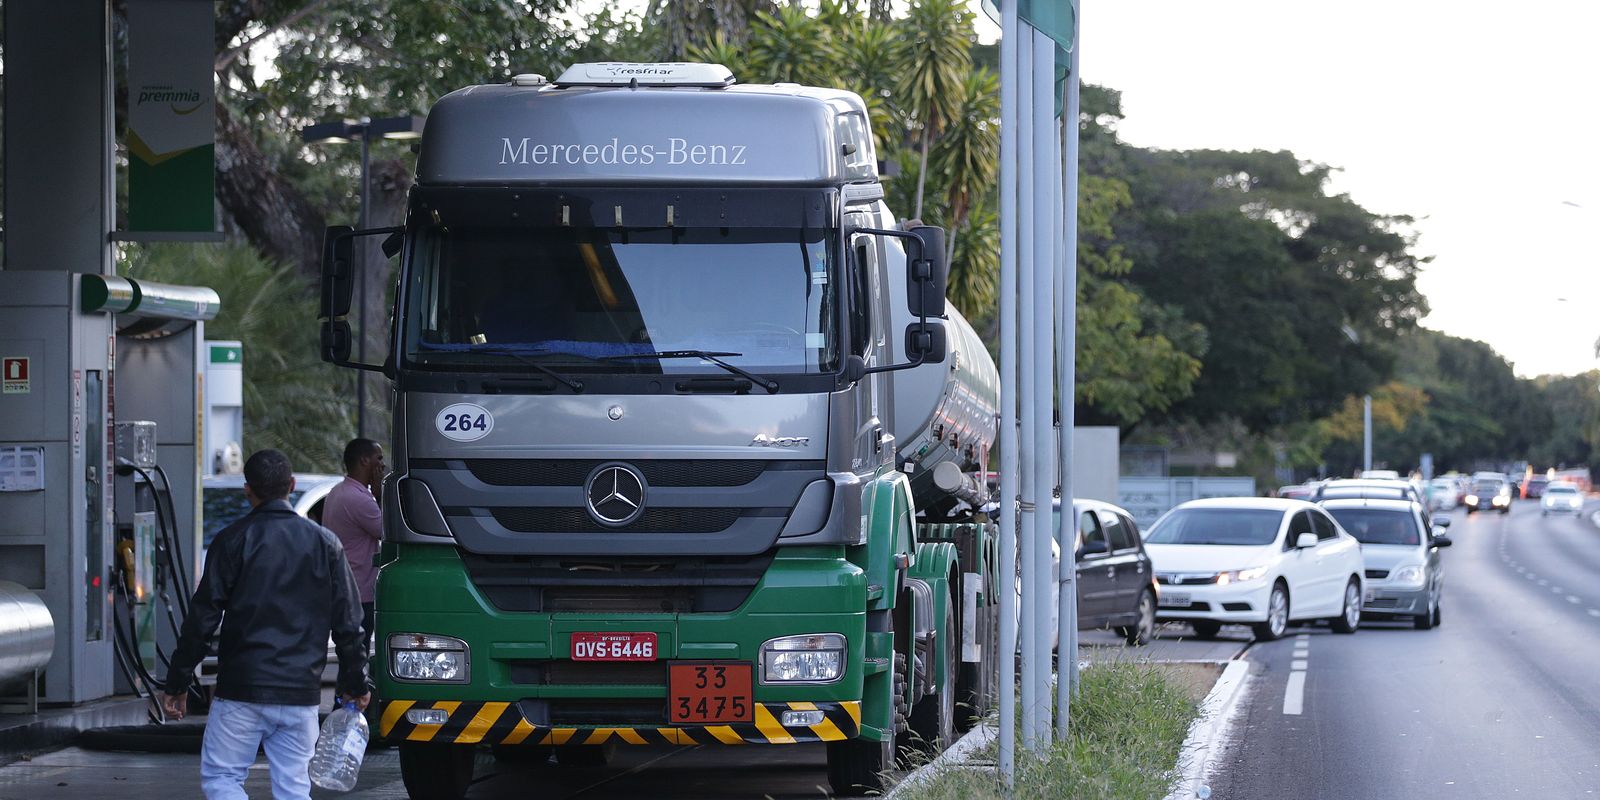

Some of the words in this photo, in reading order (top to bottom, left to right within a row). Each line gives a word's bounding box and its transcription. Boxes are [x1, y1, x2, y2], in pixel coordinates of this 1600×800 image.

[620, 67, 674, 75] resfriar
[137, 89, 200, 106] premmia
[498, 137, 747, 165] Mercedes-Benz
[444, 413, 487, 432] 264
[694, 667, 726, 689] 33
[678, 697, 745, 719] 3475
